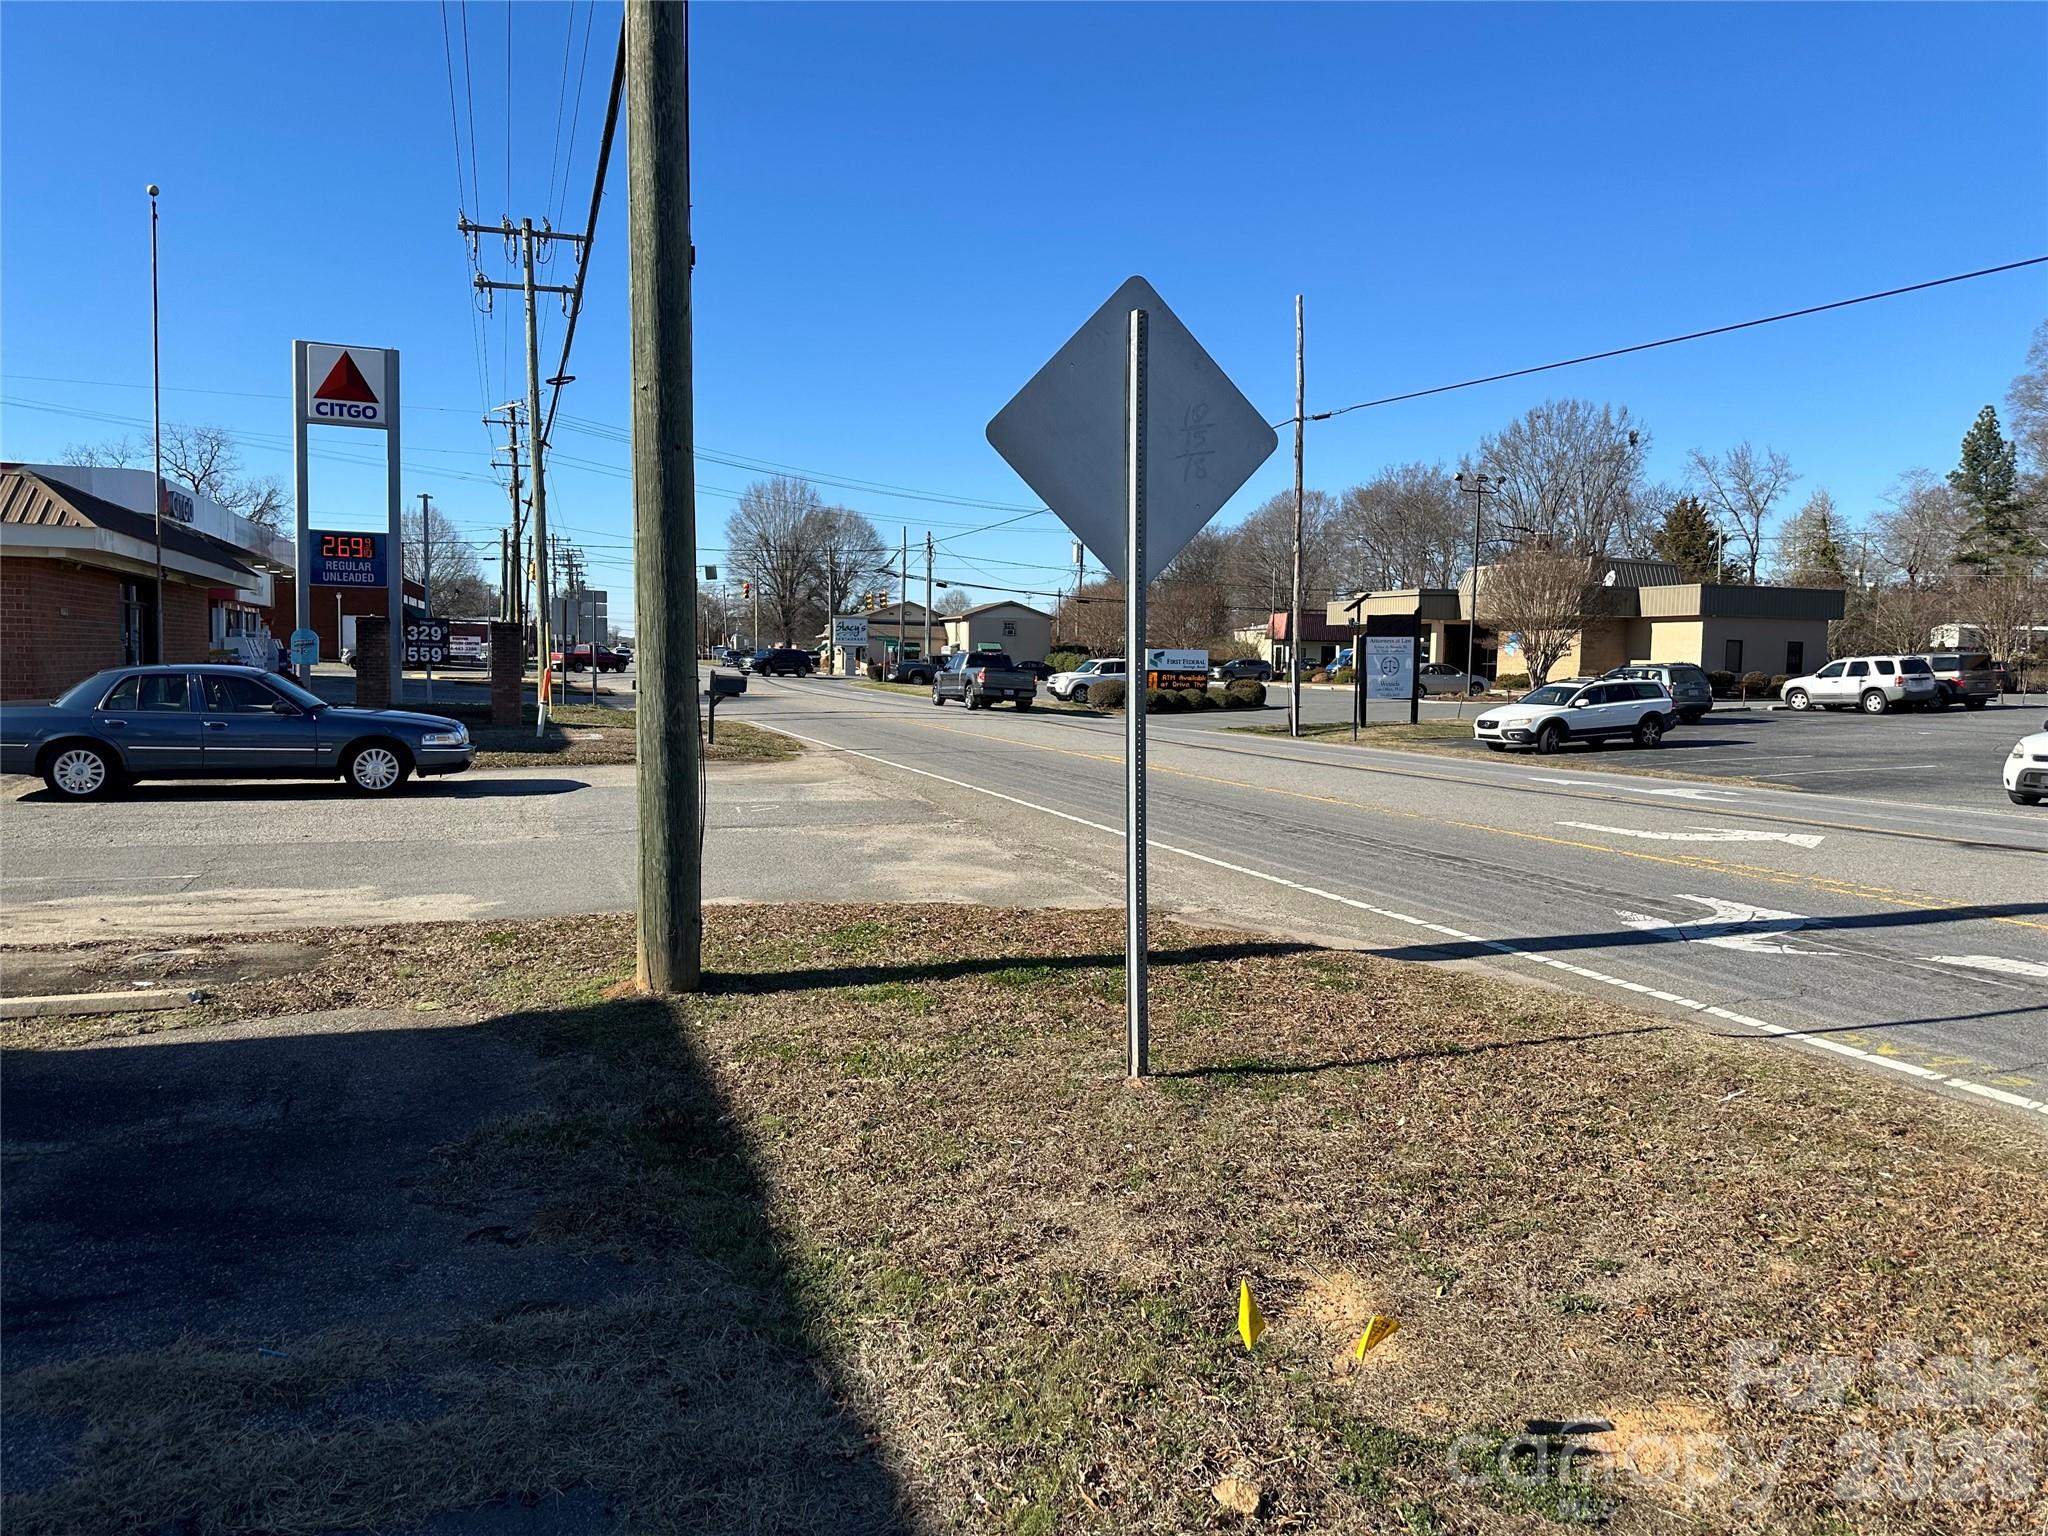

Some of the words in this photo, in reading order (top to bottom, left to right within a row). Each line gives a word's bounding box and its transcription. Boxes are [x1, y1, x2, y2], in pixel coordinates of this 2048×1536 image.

[315, 402, 377, 420] CITGO
[325, 560, 372, 572] REGULAR
[322, 571, 375, 583] UNLEADED
[407, 625, 442, 641] 329
[836, 621, 866, 637] Stacy's
[407, 647, 442, 662] 559
